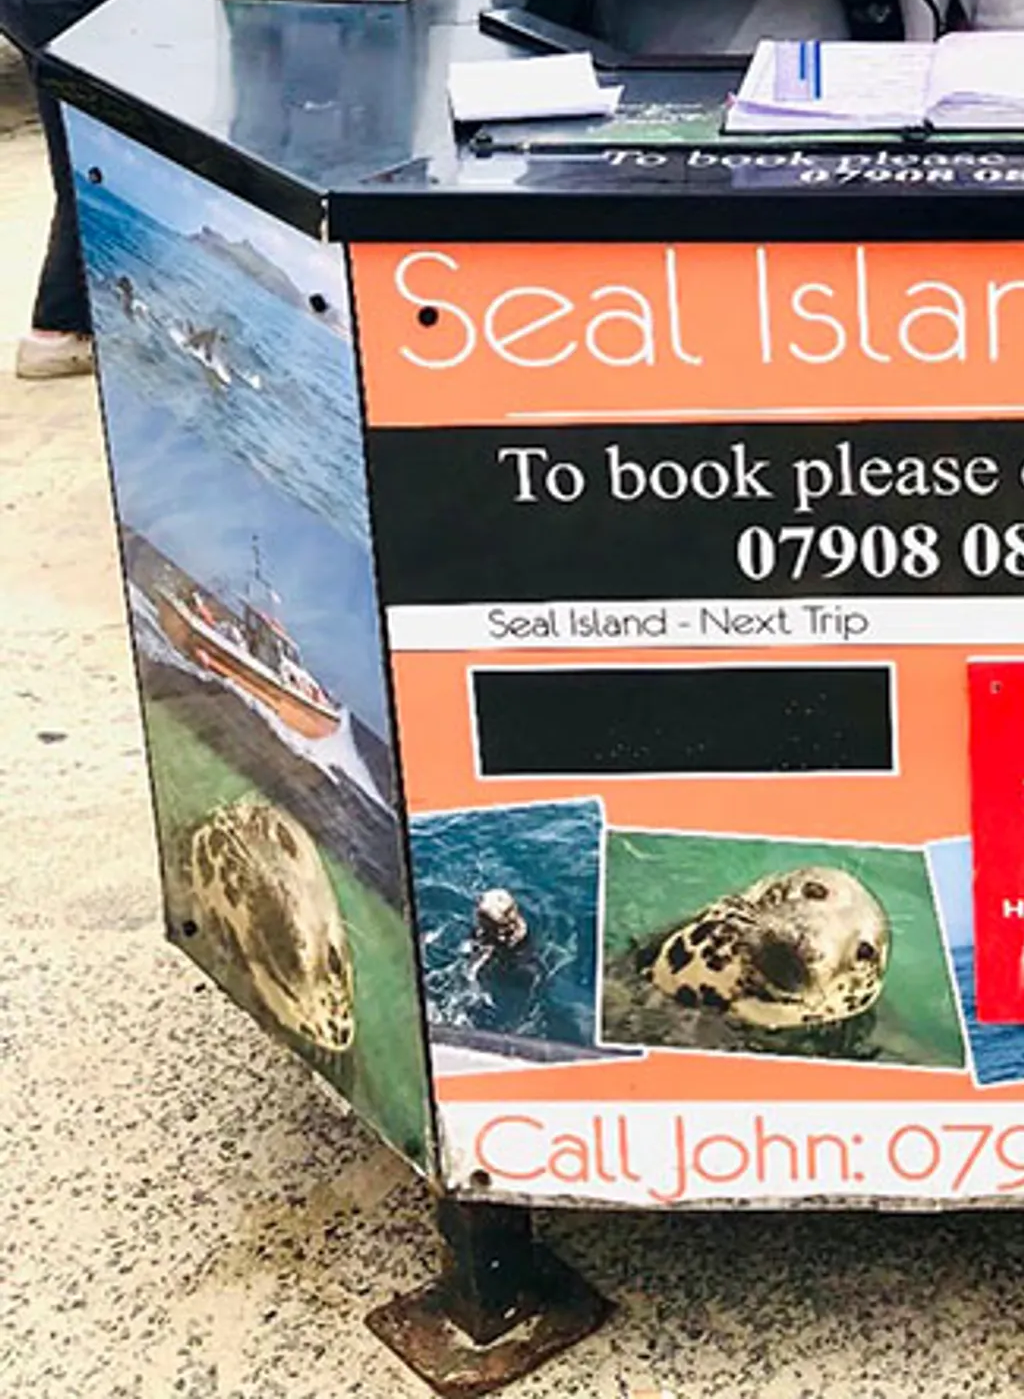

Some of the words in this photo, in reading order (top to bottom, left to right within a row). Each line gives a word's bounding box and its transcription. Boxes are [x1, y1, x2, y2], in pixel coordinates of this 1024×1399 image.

[603, 150, 667, 167] To
[688, 150, 813, 166] book
[395, 247, 701, 368] Seal
[499, 447, 586, 501] To
[605, 443, 774, 499] book
[793, 441, 999, 512] please
[736, 524, 941, 580] 07908
[487, 608, 560, 639] Seal
[570, 607, 667, 638] Island
[701, 606, 793, 637] Next
[804, 605, 870, 641] Trip
[474, 1114, 641, 1183] Call
[648, 1114, 865, 1201] John:
